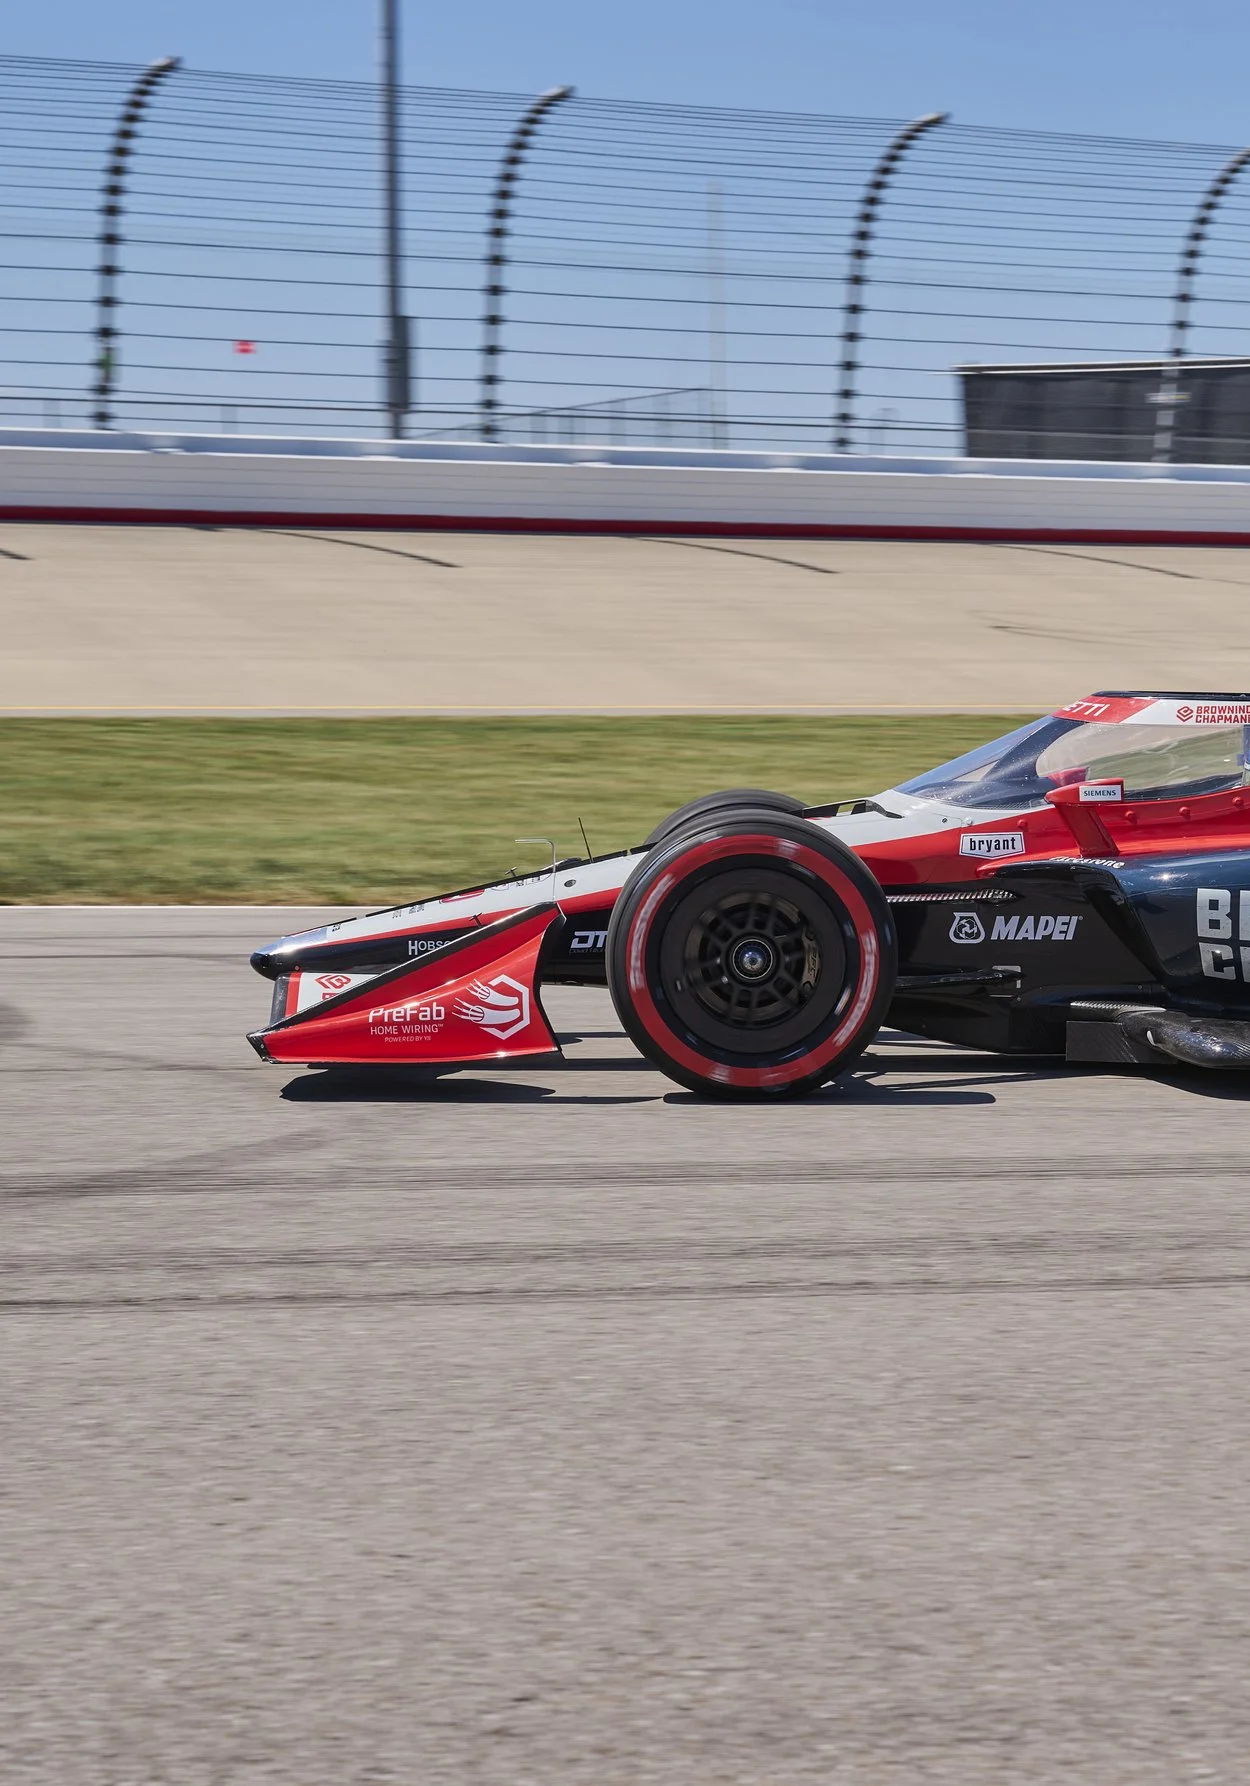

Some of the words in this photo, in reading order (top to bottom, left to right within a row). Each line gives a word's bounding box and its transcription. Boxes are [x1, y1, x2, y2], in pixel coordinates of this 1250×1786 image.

[1195, 714, 1248, 723] CHAPMAN
[1083, 789, 1117, 797] SIEMENS
[969, 836, 1017, 853] bryant
[990, 915, 1078, 940] MAPEI
[368, 1002, 446, 1023] PreFab
[370, 1025, 399, 1035] HOME
